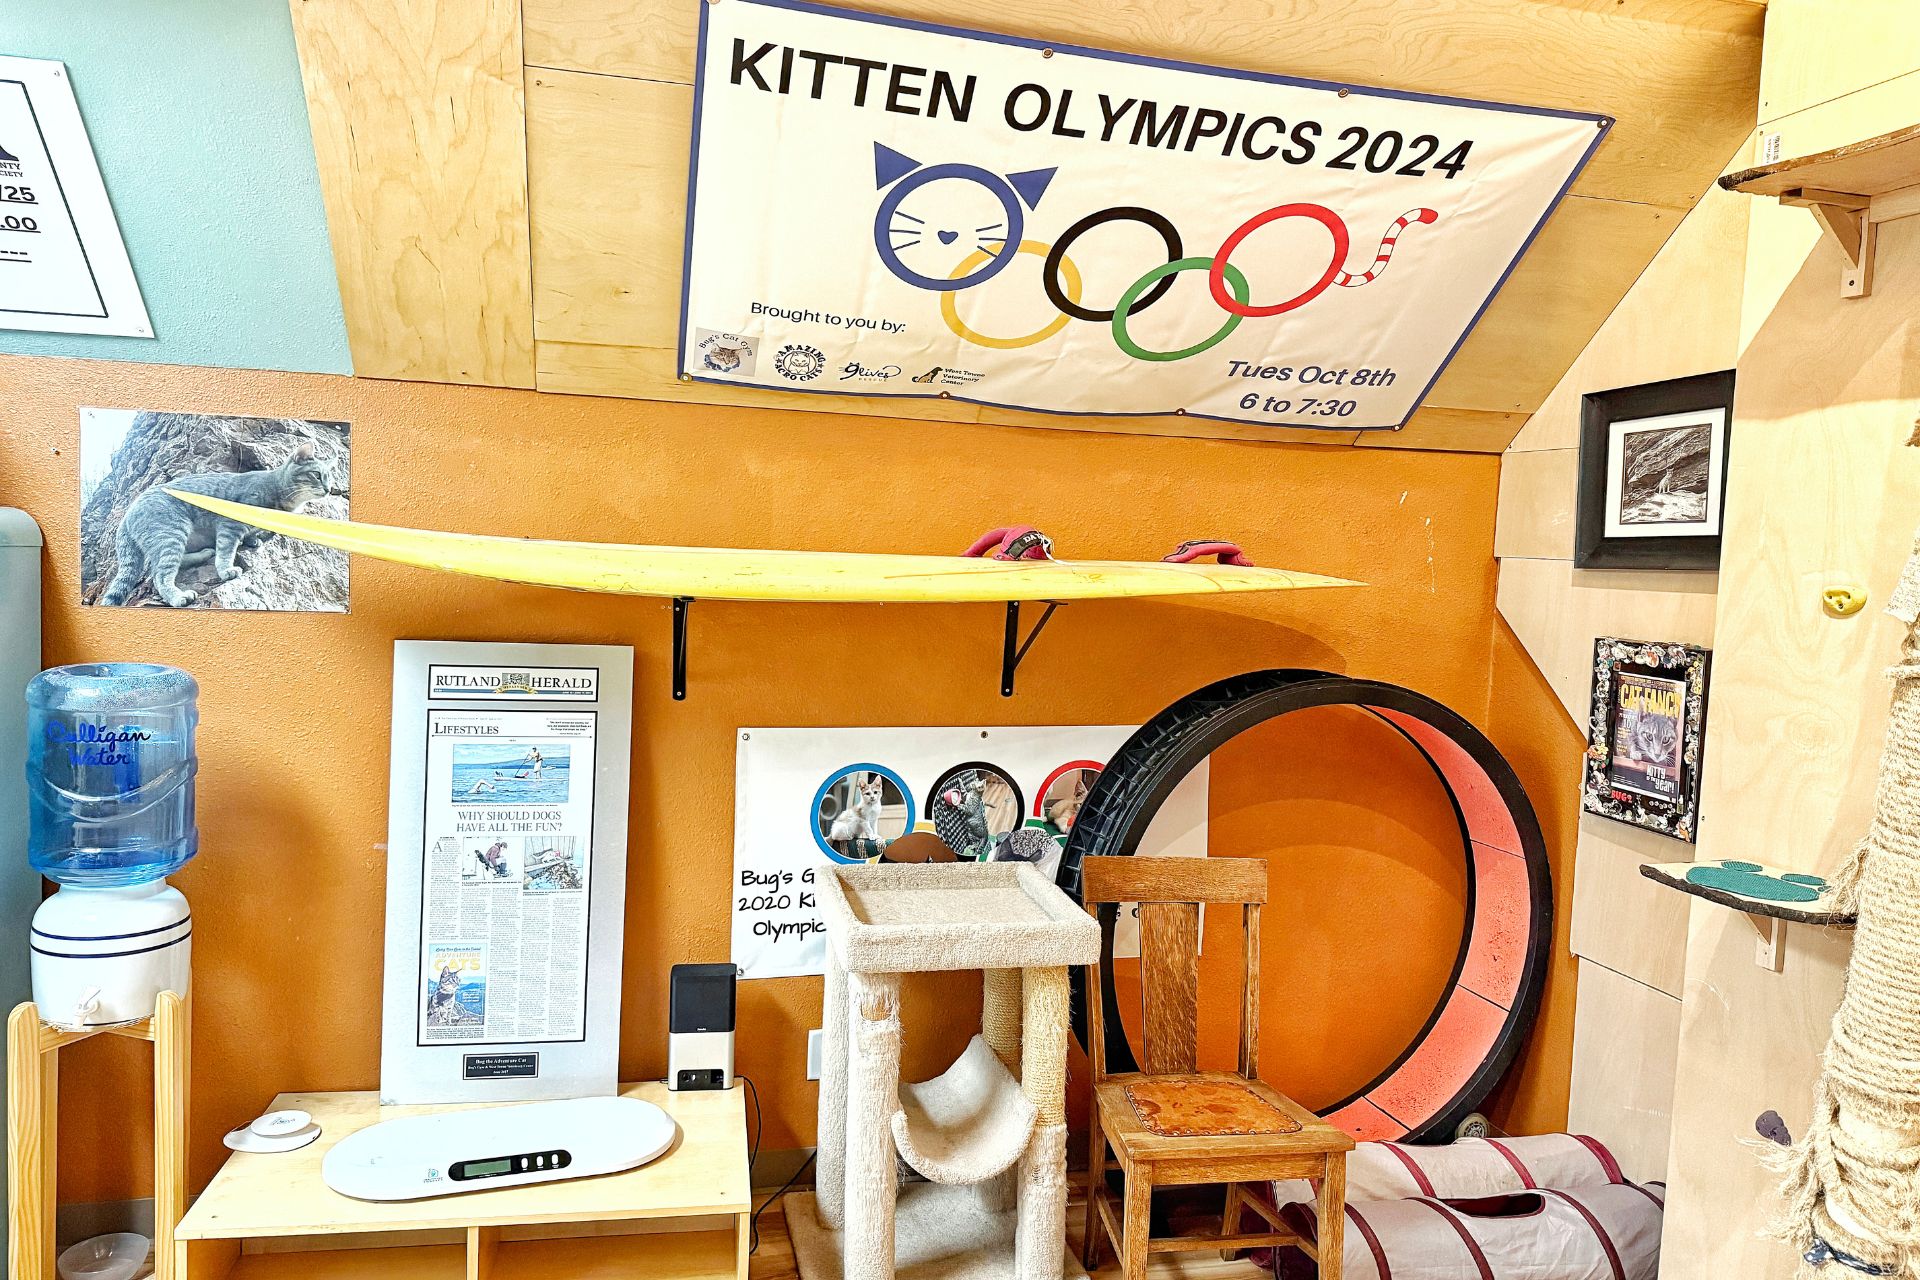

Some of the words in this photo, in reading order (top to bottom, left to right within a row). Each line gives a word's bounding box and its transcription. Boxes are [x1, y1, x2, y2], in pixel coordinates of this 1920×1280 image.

[730, 38, 977, 122] KITTEN
[1003, 83, 1322, 165] OLYMPICS
[1325, 126, 1474, 179] 2024
[751, 302, 821, 323] Brought
[825, 313, 842, 325] to
[845, 317, 877, 329] you
[881, 319, 906, 334] by:
[699, 334, 720, 349] Bug's
[722, 333, 739, 342] Cat
[780, 344, 826, 363] AMAZING
[799, 369, 823, 381] CATS
[1227, 360, 1293, 381] Tues
[1298, 366, 1349, 386] Oct
[1350, 368, 1397, 387] 8th
[1239, 393, 1260, 409] 6
[1262, 396, 1291, 413] to
[1295, 398, 1357, 417] 7:30
[436, 675, 501, 687] RUTLAND
[532, 677, 592, 689] HERALD
[1621, 683, 1642, 712] CAT
[1644, 687, 1681, 719] FANCY
[458, 811, 485, 820] WHY
[487, 811, 530, 821] SHOULD
[533, 811, 562, 820] DOGS
[457, 823, 485, 832] HAVE
[488, 823, 508, 832] ALL
[511, 823, 532, 832] THE
[535, 822, 562, 832] FUN?
[742, 870, 793, 893] Bug's
[739, 895, 791, 911] 2020
